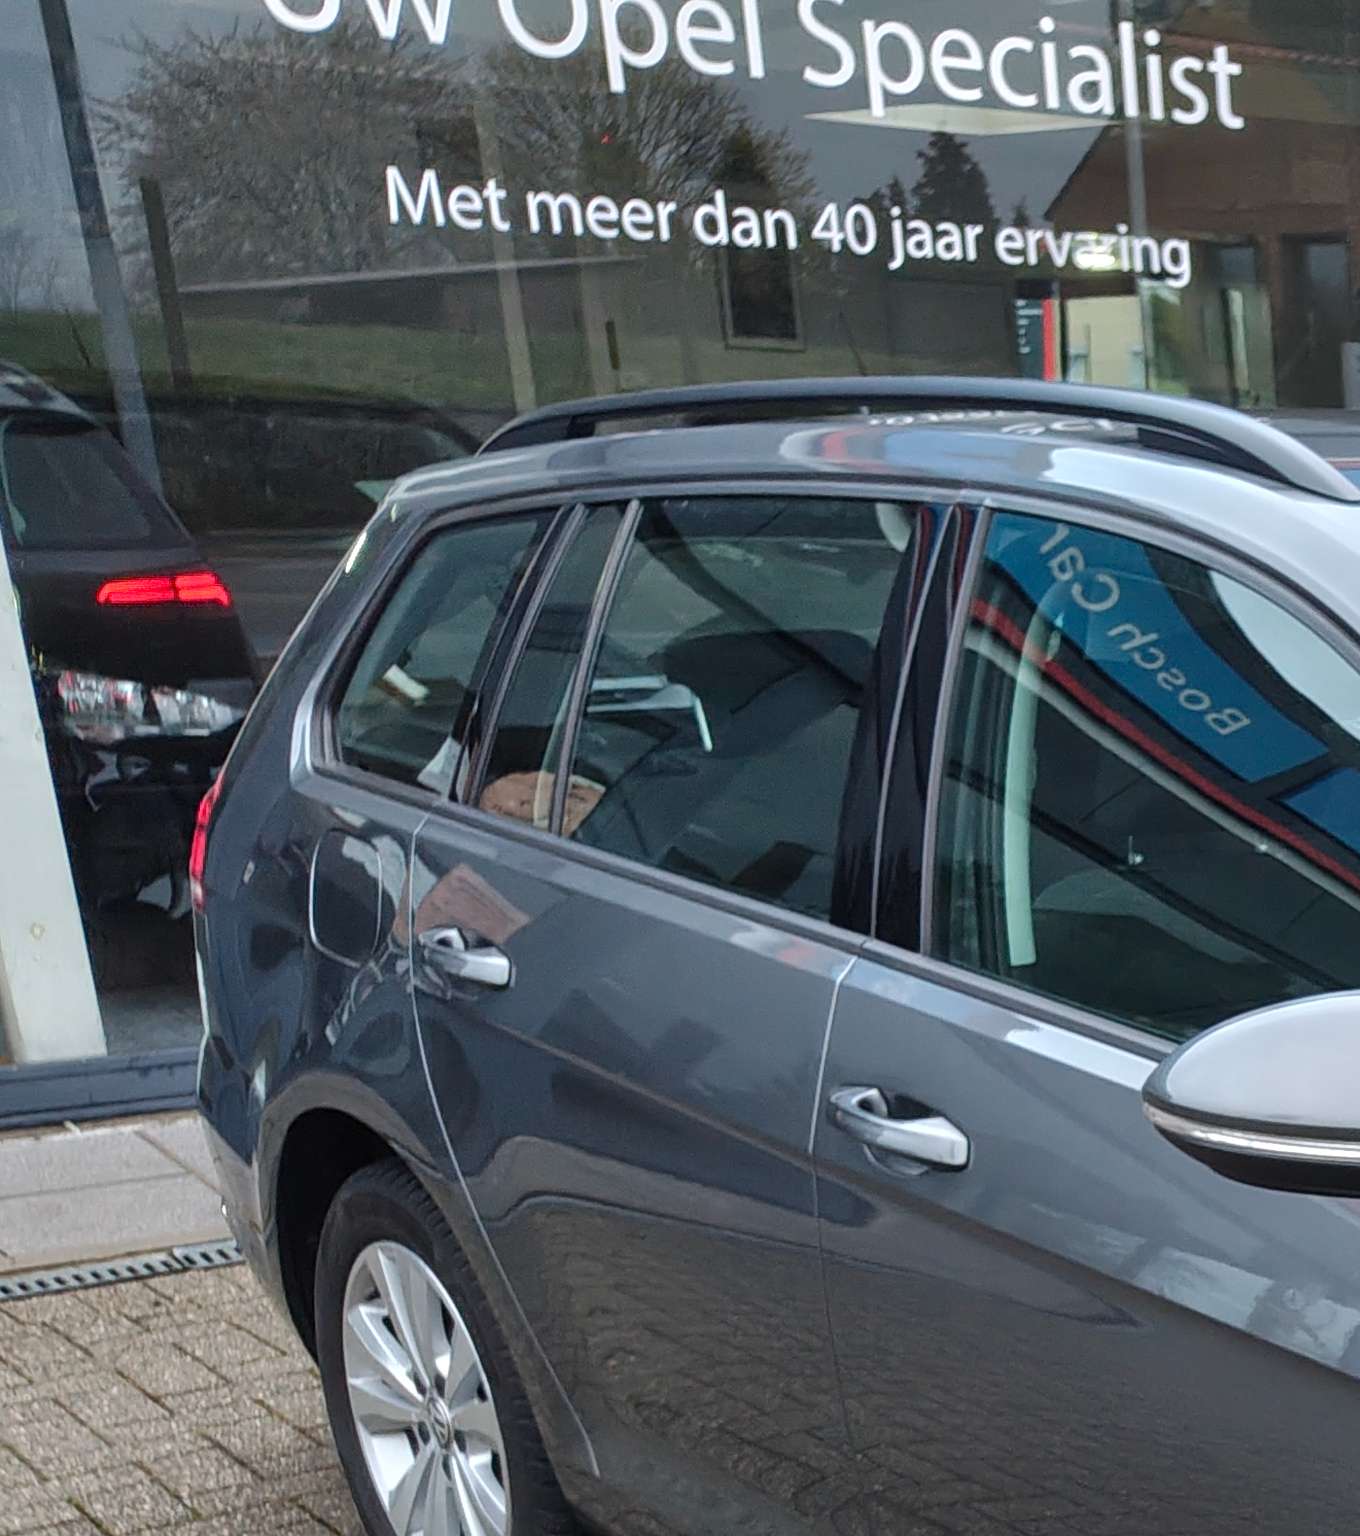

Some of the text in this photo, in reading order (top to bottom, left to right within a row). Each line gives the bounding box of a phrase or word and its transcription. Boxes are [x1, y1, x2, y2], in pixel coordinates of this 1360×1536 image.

[500, 0, 766, 94] Opel
[799, 0, 1246, 129] Specialist
[385, 165, 1192, 288] Met meer dan 40 jaar ervaring
